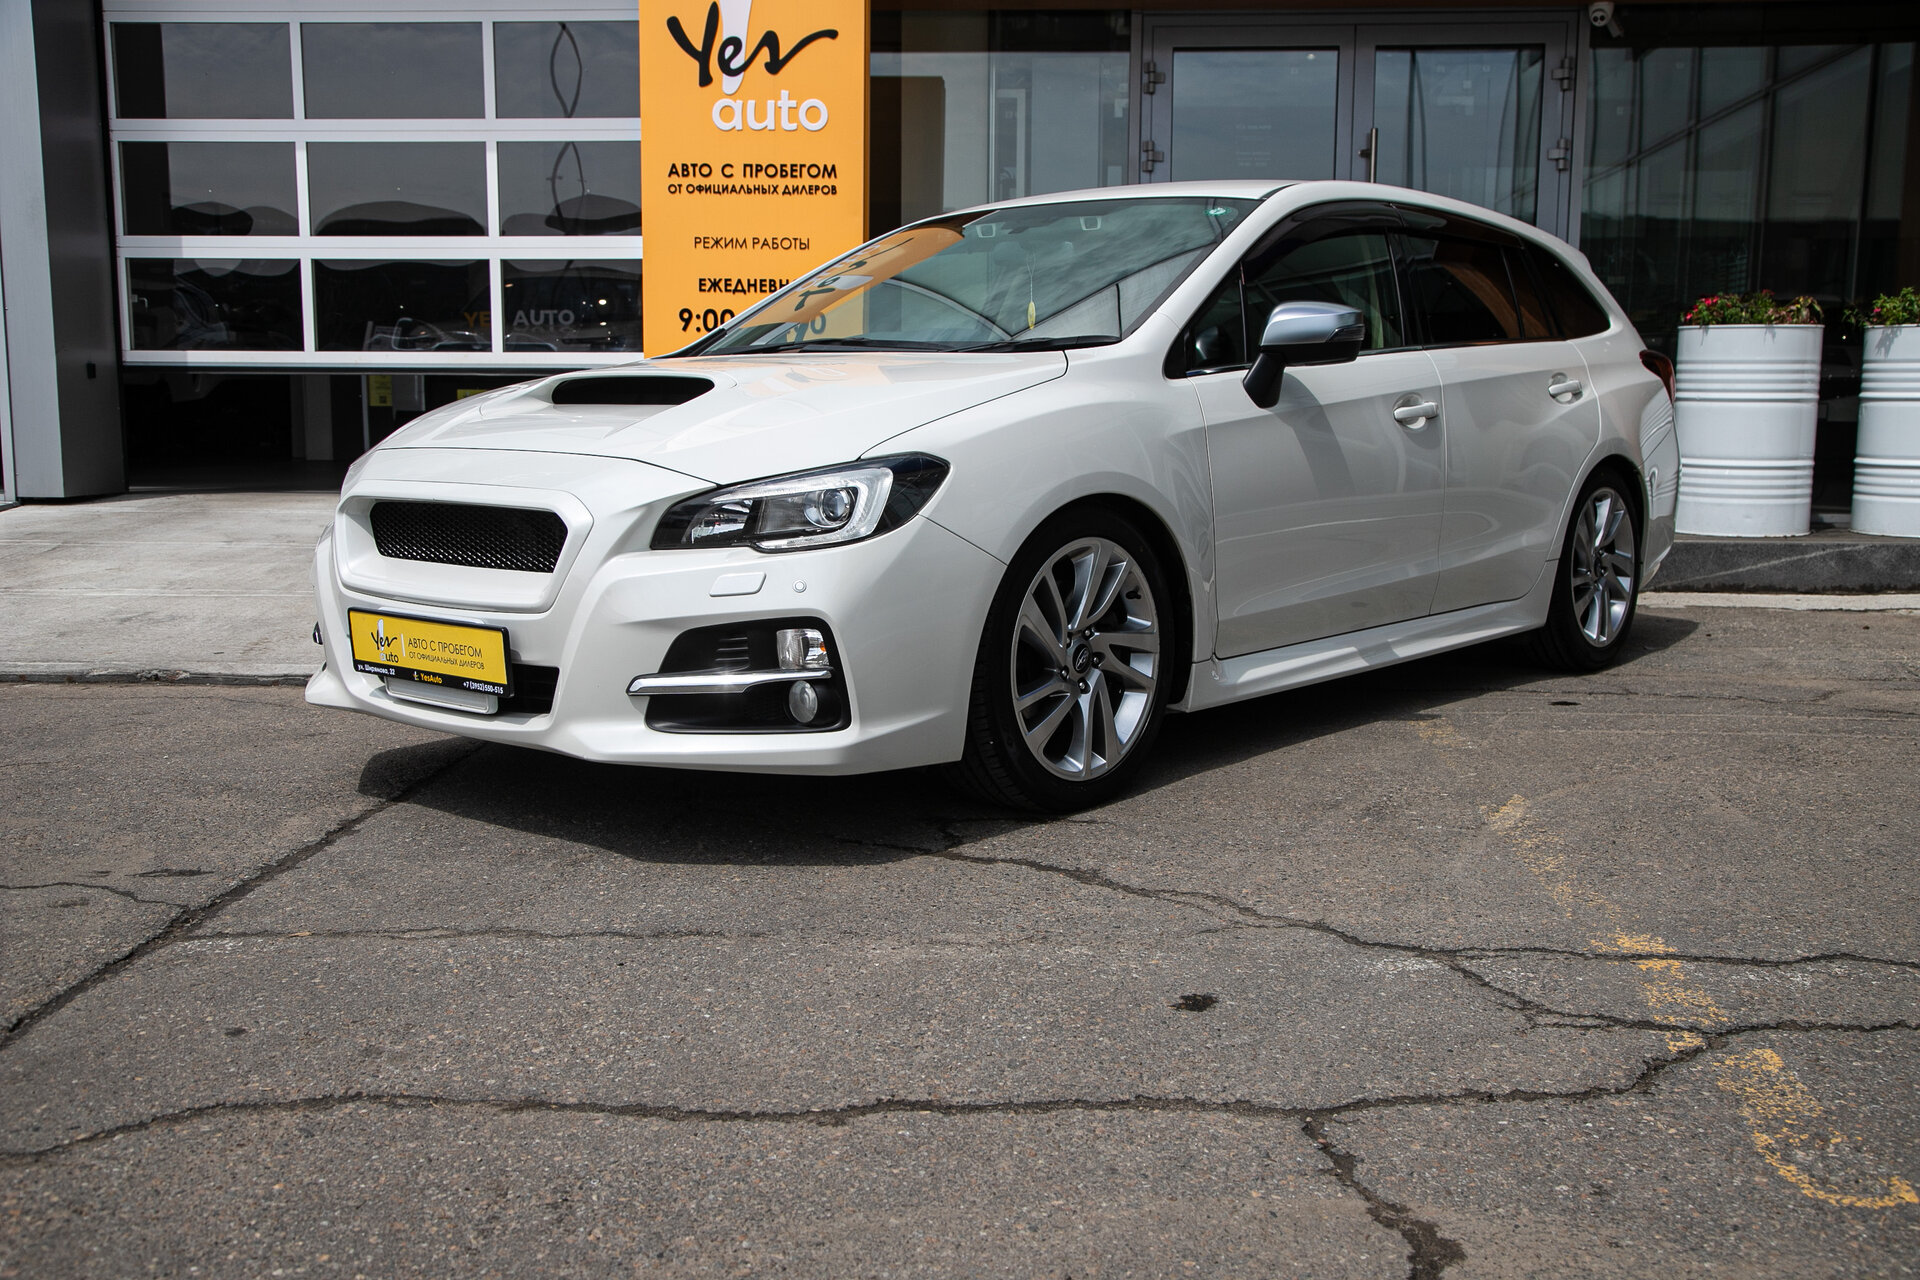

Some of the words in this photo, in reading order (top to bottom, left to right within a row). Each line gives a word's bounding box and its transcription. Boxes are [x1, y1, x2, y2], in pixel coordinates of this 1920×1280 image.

[711, 89, 829, 132] auto
[667, 163, 713, 178] АВТО
[720, 163, 735, 178] С
[743, 163, 838, 179] ПРОБЕГОМ
[667, 183, 683, 195] ОТ
[685, 183, 779, 196] ОФИЦИАЛЬНЫХ
[781, 184, 838, 196] ДИЛЕРОВ
[693, 236, 748, 249] РЕЖИМ
[752, 237, 810, 250] РАБОТЫ
[698, 278, 793, 295] ЕЖЕДНЕВН
[464, 311, 491, 328] YE
[512, 309, 576, 327] AUTO
[408, 637, 428, 650] АВТО
[429, 640, 437, 652] С
[437, 641, 483, 658] ПРОБЕГОМ
[380, 651, 399, 663] auto
[416, 652, 457, 665] ОФИЦИАЛЬНЫХ
[458, 660, 485, 670] ДИЛЕРОВ
[420, 673, 443, 684] YesAuto
